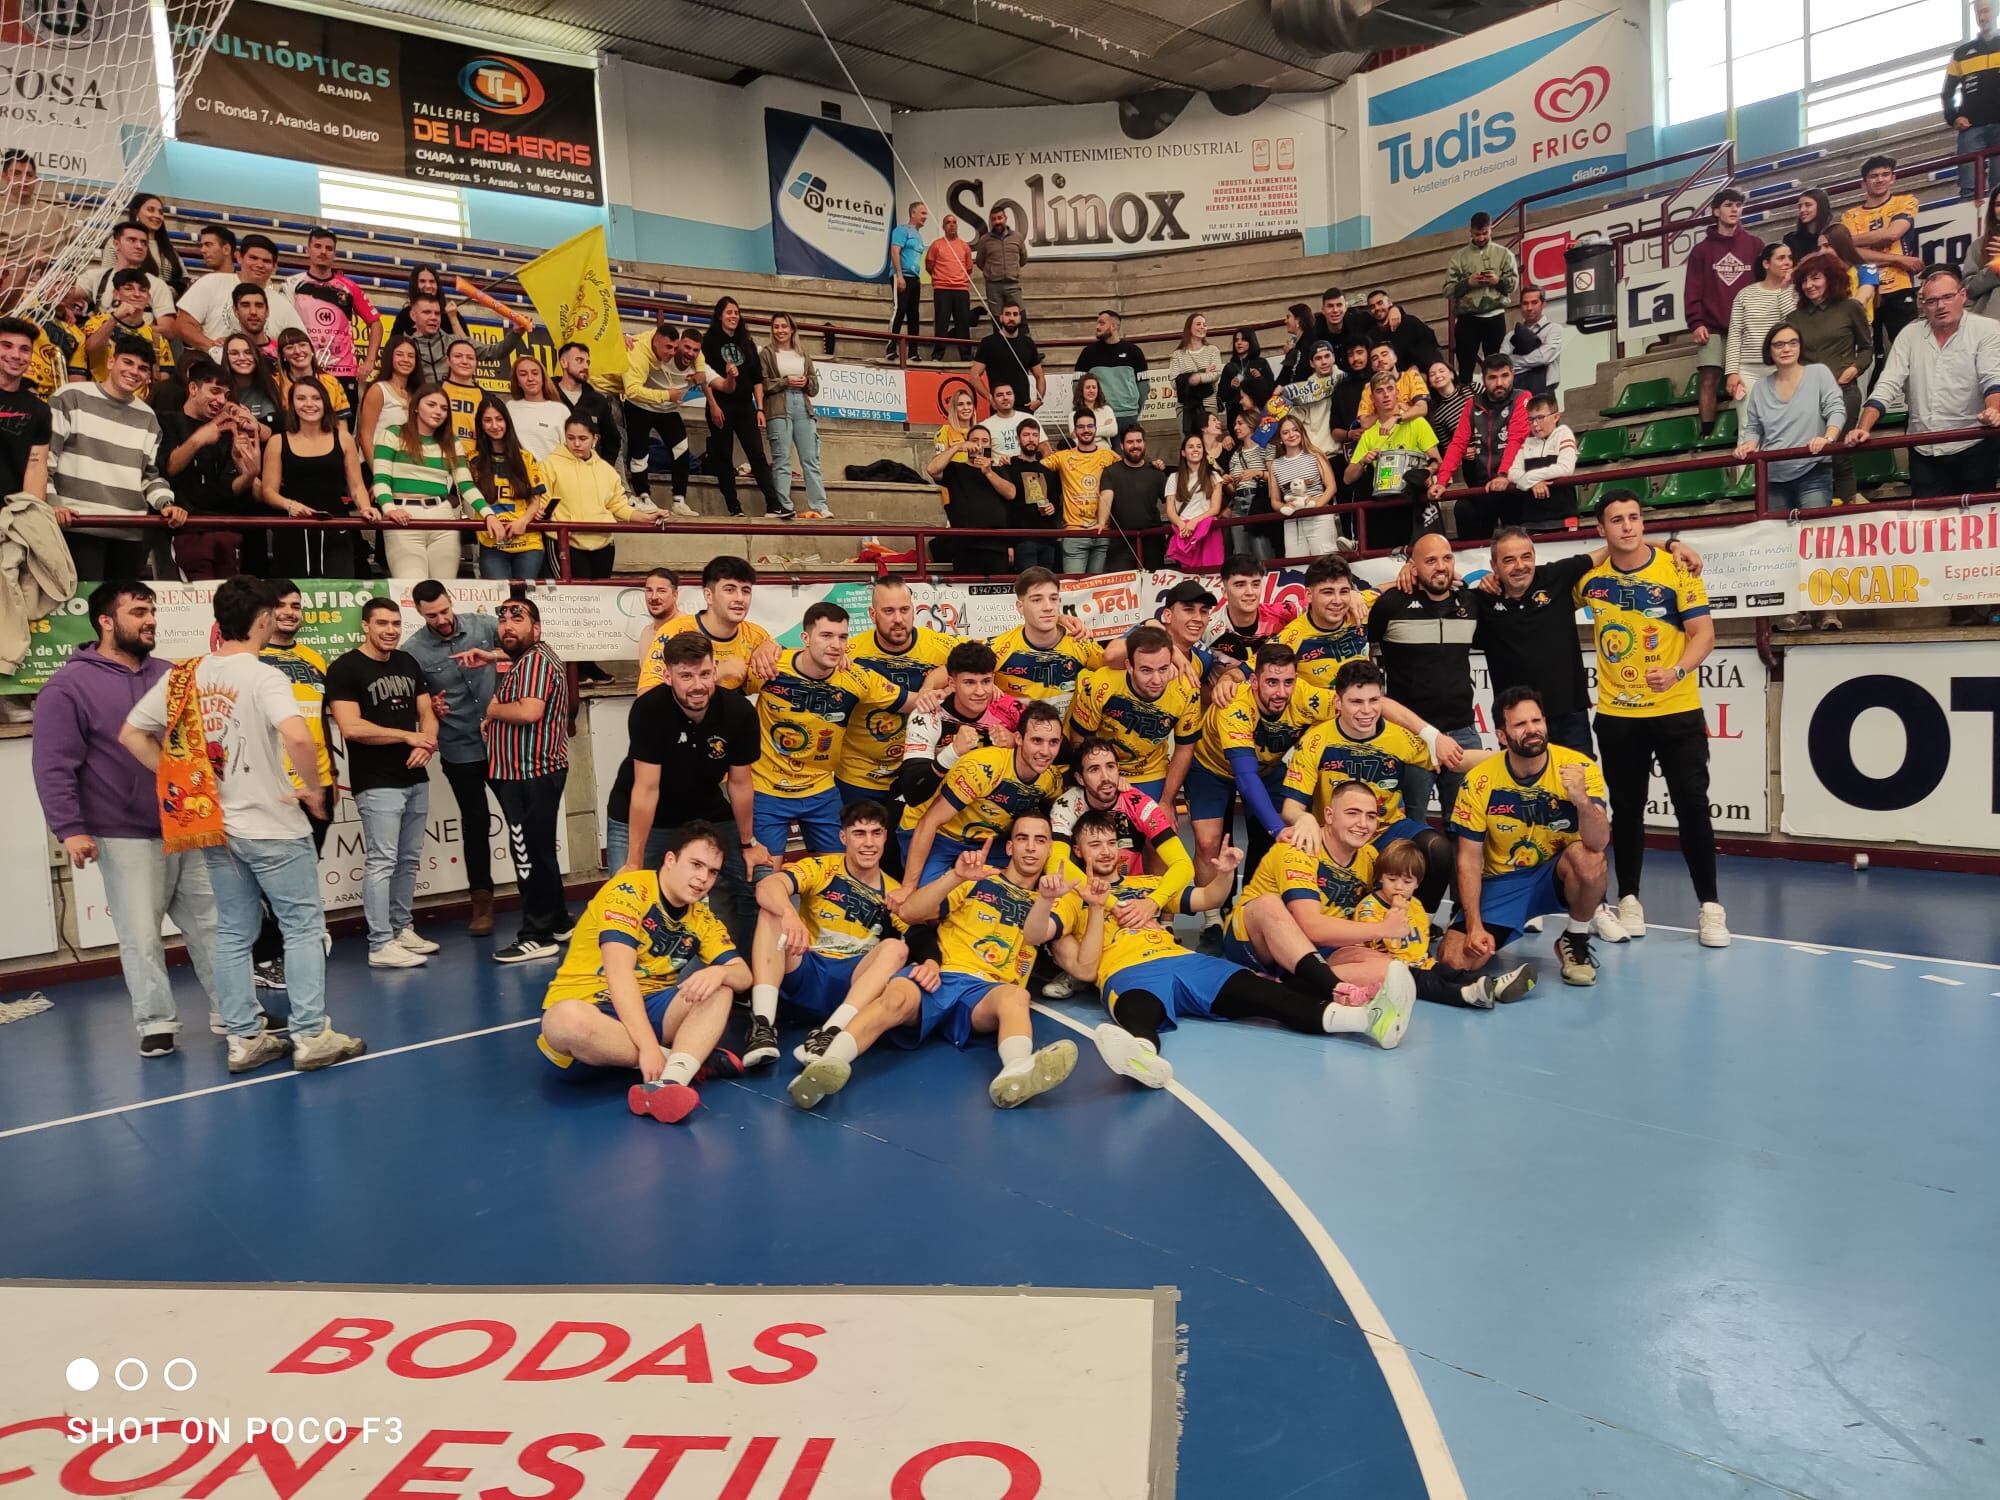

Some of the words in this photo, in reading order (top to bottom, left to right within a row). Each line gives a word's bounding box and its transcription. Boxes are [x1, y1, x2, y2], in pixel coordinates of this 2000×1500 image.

[317, 83, 373, 102] ARANDA
[478, 68, 524, 105] TH
[413, 102, 480, 123] TALLERES
[214, 101, 258, 121] Ronda
[275, 113, 321, 133] Aranda
[323, 122, 340, 136] de
[342, 125, 380, 143] Duero
[413, 118, 450, 145] DE
[454, 125, 592, 167] LASHERAS
[1378, 109, 1517, 185] Tudis
[1532, 122, 1612, 163] FRIGO
[943, 152, 1011, 169] MONTAJE
[1016, 152, 1025, 165] Y
[1029, 147, 1153, 165] MANTENIMIENTO
[1157, 140, 1243, 159] INDUSTRIAL
[416, 149, 455, 164] CHAPA
[470, 158, 522, 173] PINTURA
[536, 167, 593, 184] MECÁNICA
[1463, 156, 1519, 181] Profesional
[488, 177, 519, 189] Aranda
[543, 184, 561, 195] 947
[1218, 179, 1252, 187] INDUSTRIA
[1212, 187, 1247, 195] INDUSTRIA
[946, 172, 1190, 248] Solinox
[1205, 204, 1229, 212] HIERRO
[830, 369, 897, 387] GESTORÍA
[822, 386, 902, 405] FINANCIACIÓN
[847, 410, 861, 418] 947
[1702, 552, 1719, 561] app
[1722, 550, 1745, 560] para
[1740, 559, 1798, 573] información
[1151, 573, 1177, 586] 947
[1731, 579, 1776, 590] Comarca
[1807, 564, 1920, 606] OSCAR
[979, 585, 990, 594] 947
[992, 585, 1001, 594] 50
[1943, 593, 1954, 601] C/
[1956, 592, 1974, 600] San
[300, 590, 374, 609] AFIRO
[559, 594, 601, 604] Empresarial
[304, 610, 343, 624] URS
[559, 606, 601, 614] Inmobiliaria
[583, 618, 613, 628] Seguros
[330, 633, 344, 643] de
[36, 644, 53, 657] de
[577, 643, 619, 651] Financieras
[1302, 646, 1325, 662] GSK
[1644, 655, 1661, 663] ROA
[368, 675, 416, 706] TOMMY
[1610, 699, 1655, 708] MICHELIN
[1309, 733, 1322, 755] neo
[1323, 759, 1345, 771] GSK
[1475, 774, 1489, 796] neo
[1488, 804, 1516, 815] GSK
[268, 1317, 829, 1385] BODAS
